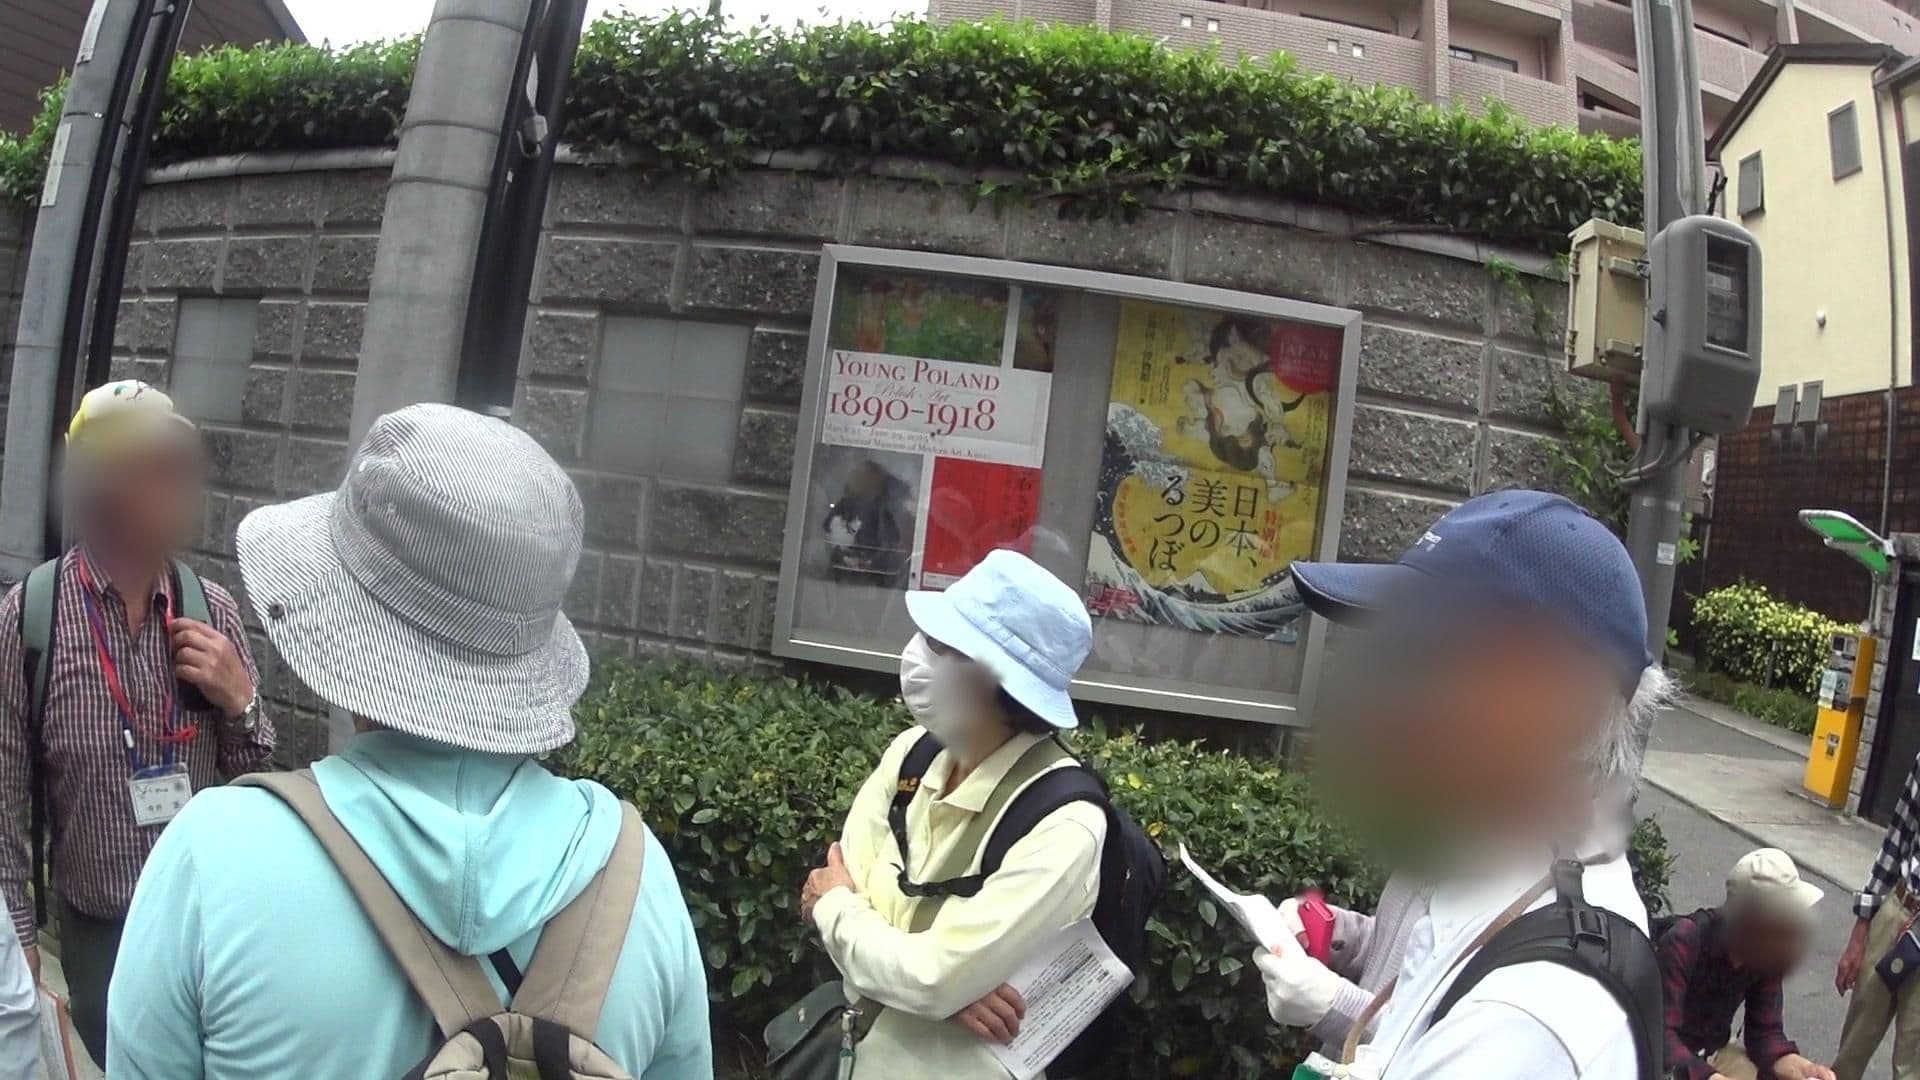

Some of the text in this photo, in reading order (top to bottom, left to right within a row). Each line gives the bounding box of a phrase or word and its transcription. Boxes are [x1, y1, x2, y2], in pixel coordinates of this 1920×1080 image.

[1149, 475, 1186, 572] るつぼ
[1189, 478, 1228, 549] 美の
